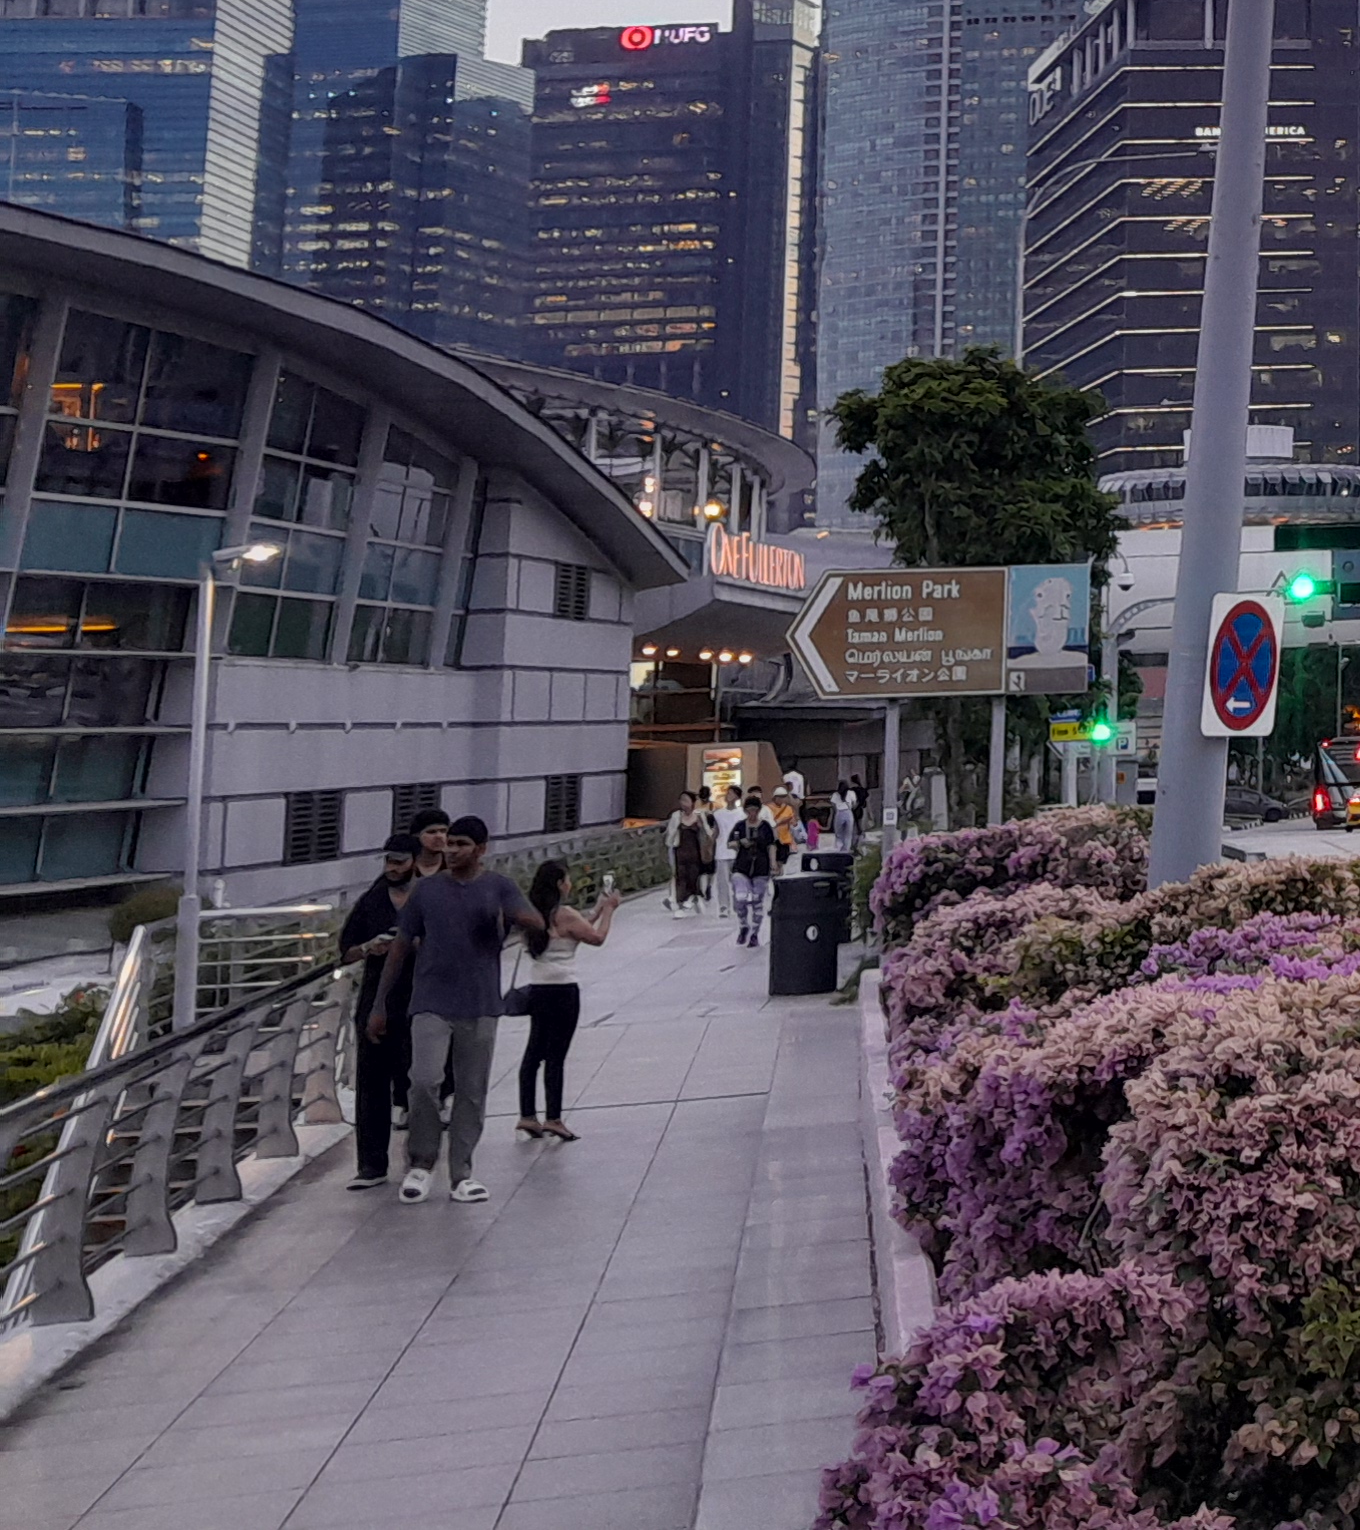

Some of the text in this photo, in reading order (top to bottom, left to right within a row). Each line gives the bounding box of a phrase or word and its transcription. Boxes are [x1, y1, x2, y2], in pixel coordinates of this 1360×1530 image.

[1195, 126, 1305, 137] BAN ERICA
[847, 579, 960, 600] Merlion Park
[847, 626, 944, 643] Taman Merlion
